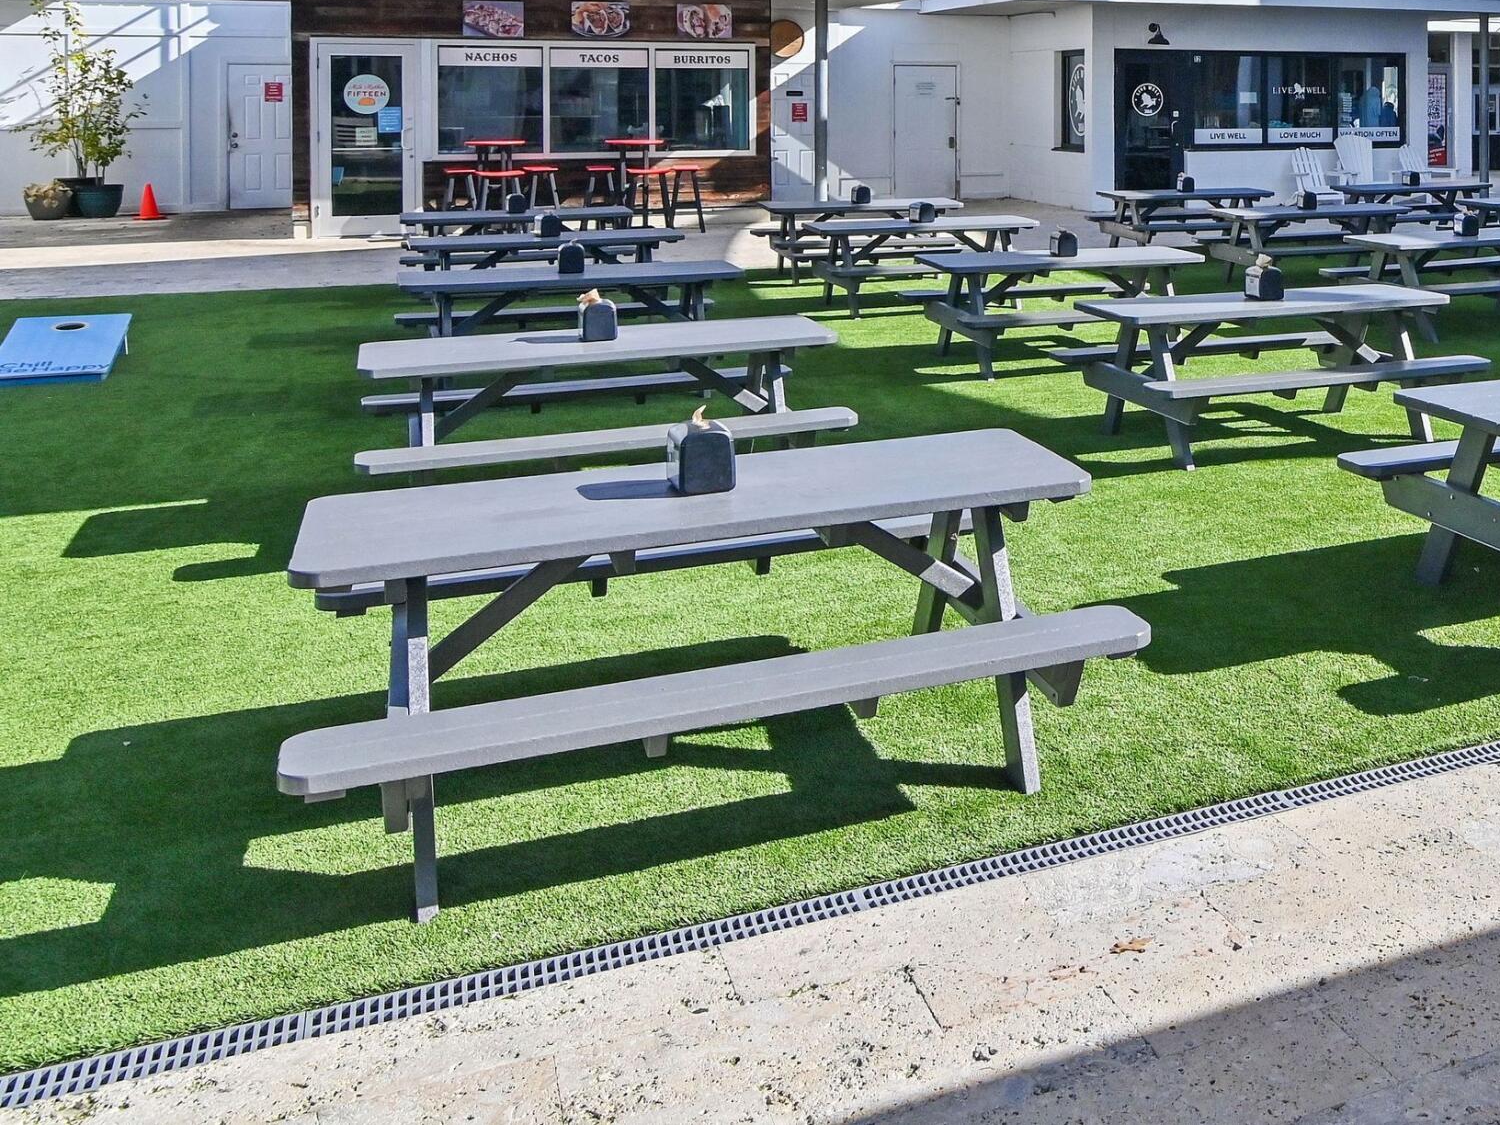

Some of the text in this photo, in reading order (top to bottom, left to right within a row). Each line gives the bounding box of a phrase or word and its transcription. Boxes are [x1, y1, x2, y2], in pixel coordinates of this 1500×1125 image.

[464, 52, 518, 62] NACHOS
[579, 53, 620, 63] TACOS
[673, 54, 731, 64] BURRITOS
[1272, 86, 1327, 95] LIVE WELL
[1209, 132, 1247, 140] LIVE WELL
[1279, 131, 1321, 139] LOVE MUCH
[1375, 130, 1398, 138] OFTEN
[0, 361, 53, 369] Chill
